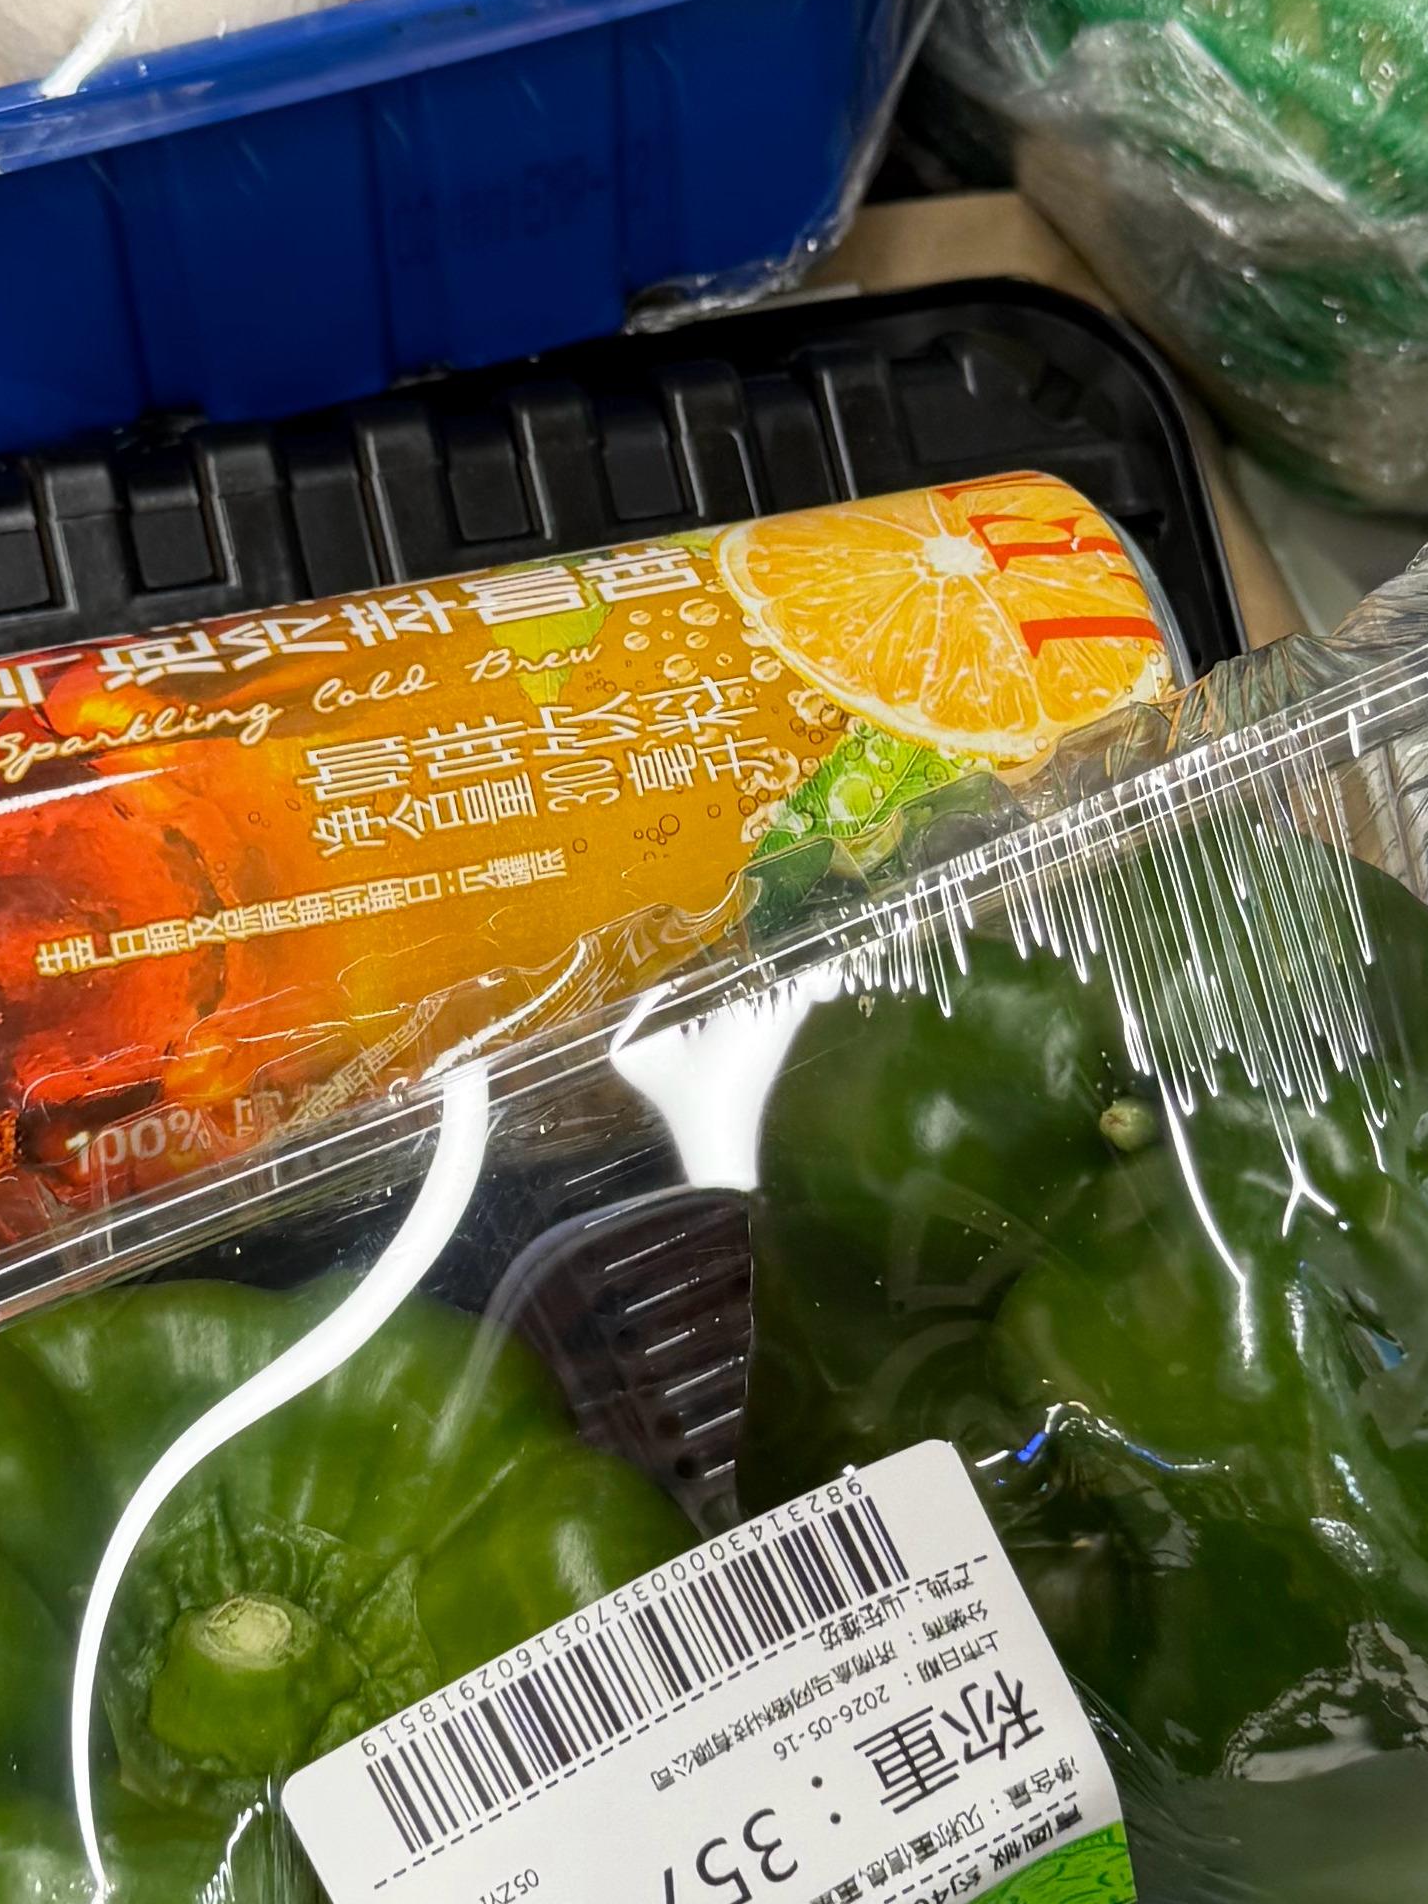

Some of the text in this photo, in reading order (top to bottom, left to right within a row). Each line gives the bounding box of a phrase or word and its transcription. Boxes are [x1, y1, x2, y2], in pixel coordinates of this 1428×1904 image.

[312, 657, 432, 718] Cold
[469, 637, 604, 693] Brew
[296, 673, 757, 804] 咖啡饮料
[65, 1099, 214, 1178] 100%
[360, 1475, 864, 1758] 98231430000357051602918519
[773, 1683, 890, 1761] 2026-05-16
